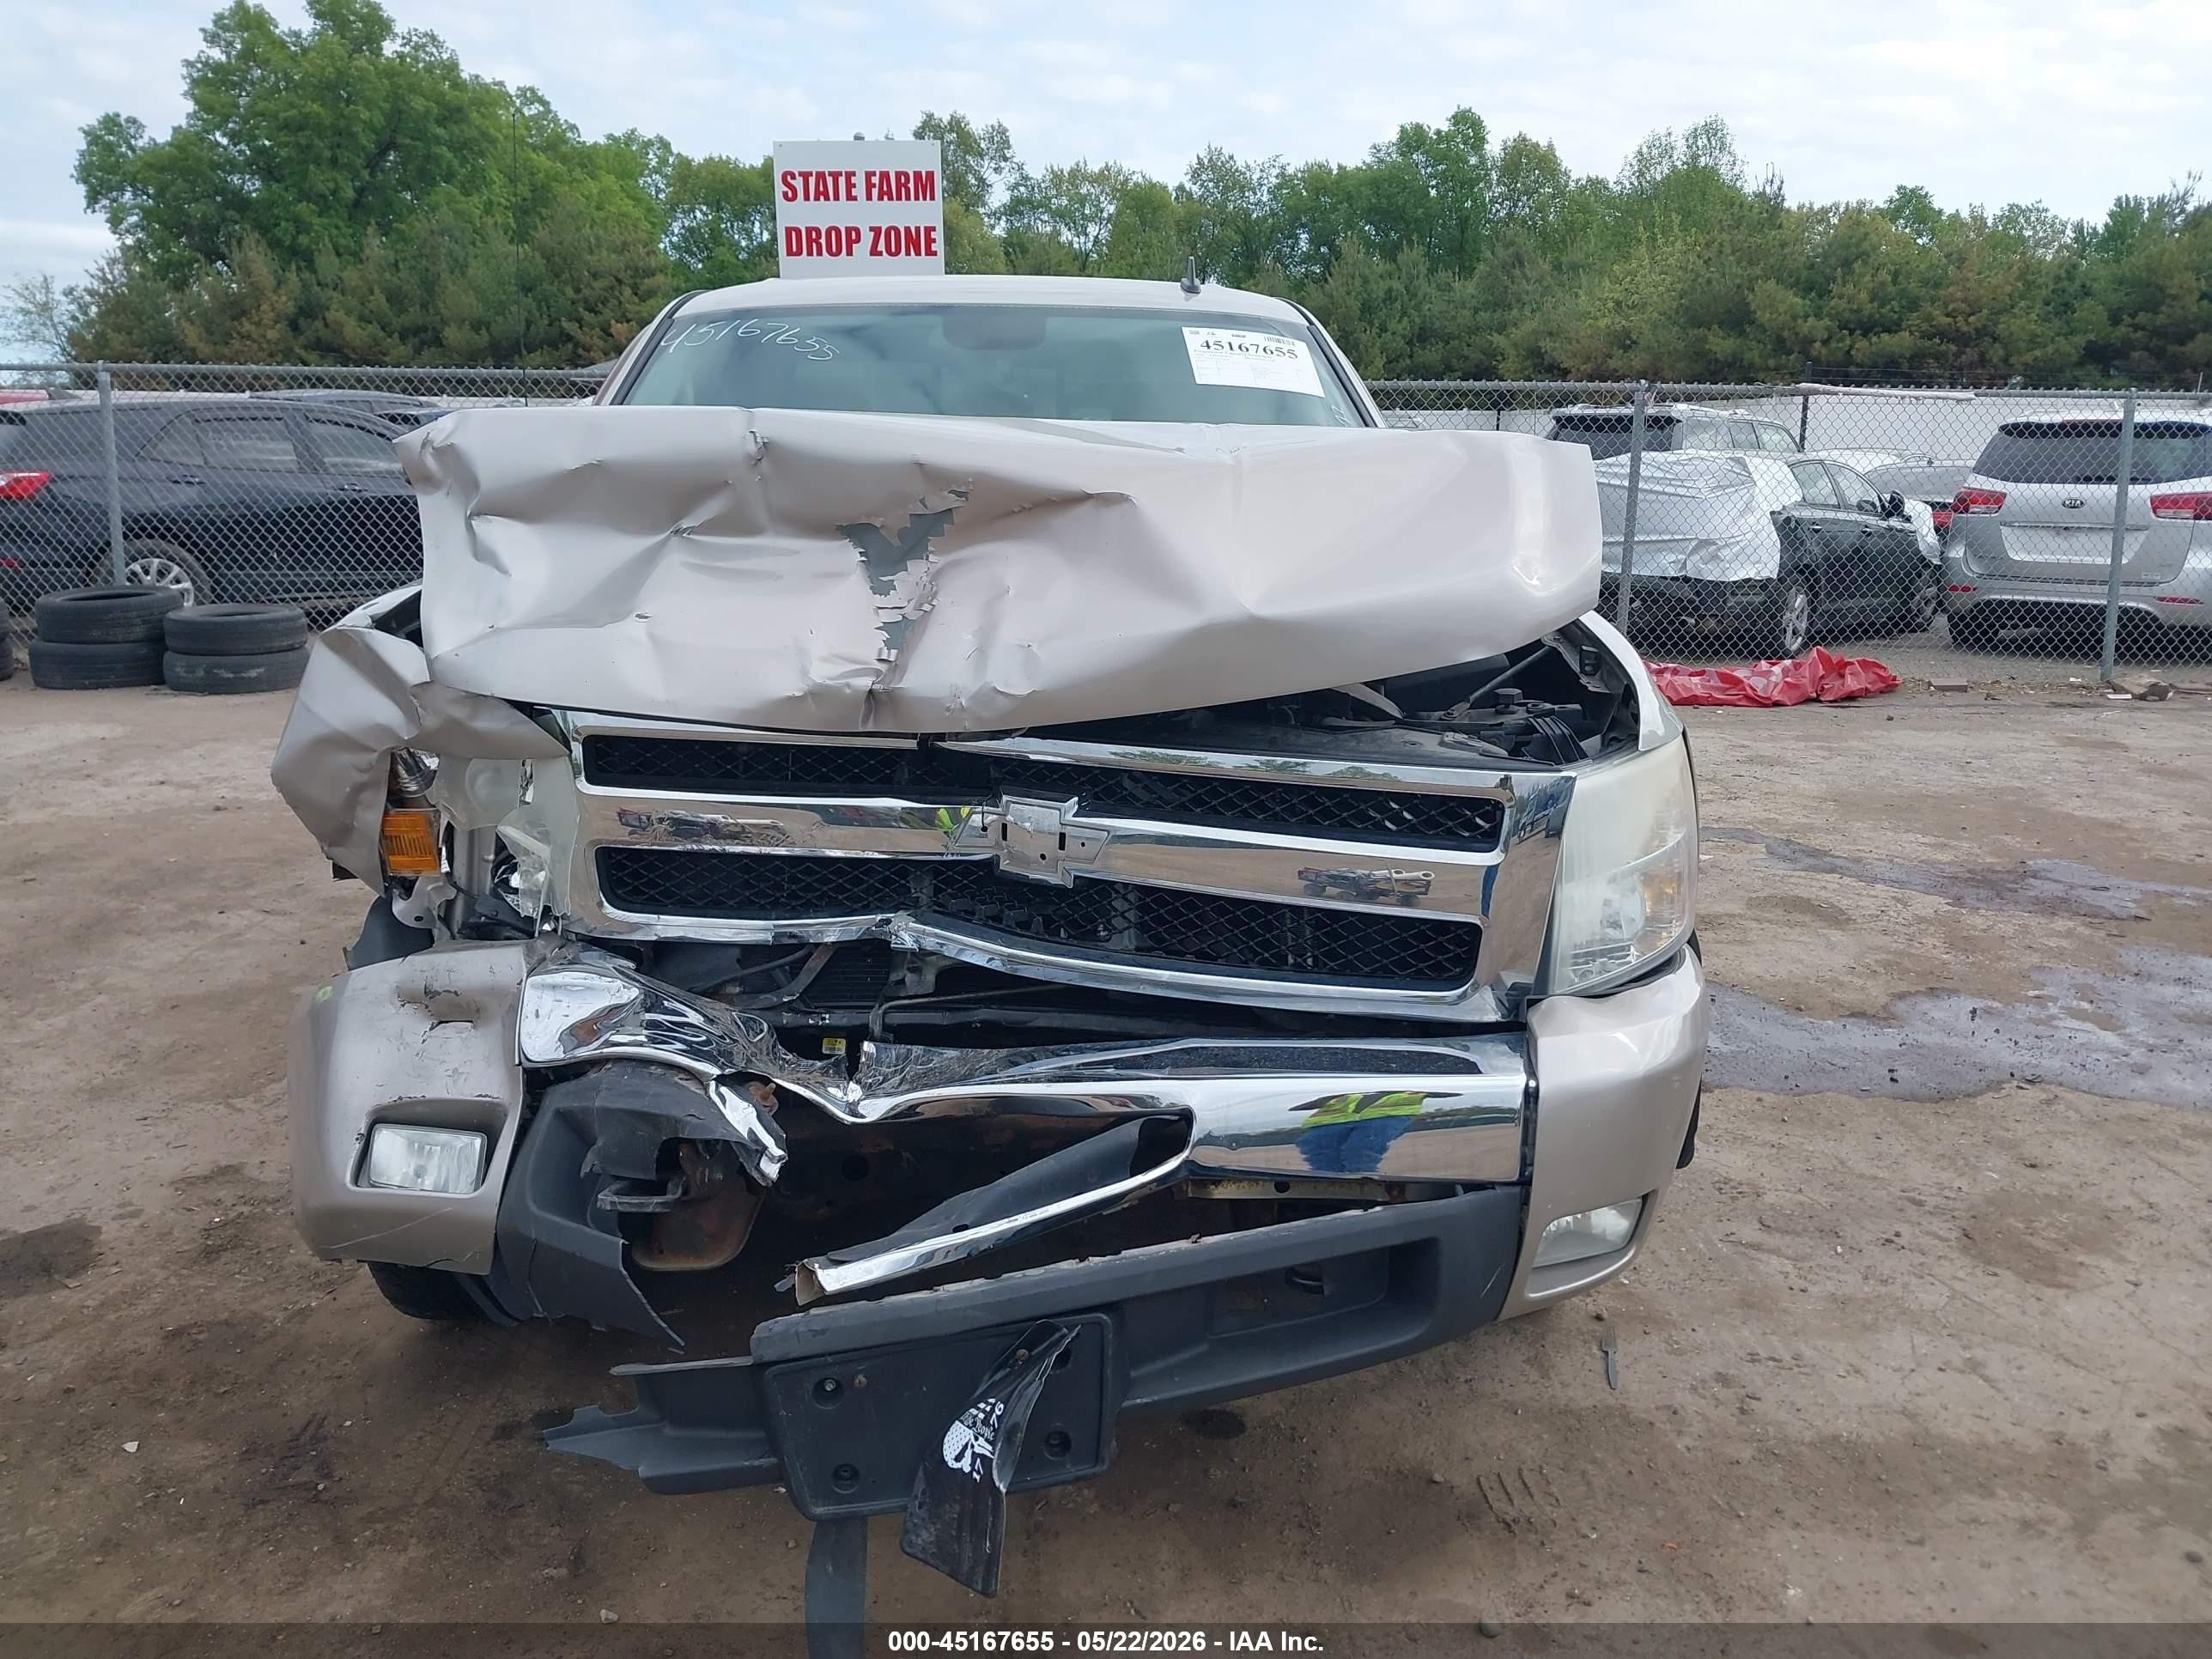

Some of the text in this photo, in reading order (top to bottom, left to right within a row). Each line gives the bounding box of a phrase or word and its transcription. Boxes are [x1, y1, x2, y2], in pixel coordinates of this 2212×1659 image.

[781, 171, 935, 202] STATE FARM
[786, 226, 937, 257] DROP ZONE
[660, 319, 841, 361] 45167655
[1200, 339, 1298, 360] 45167655
